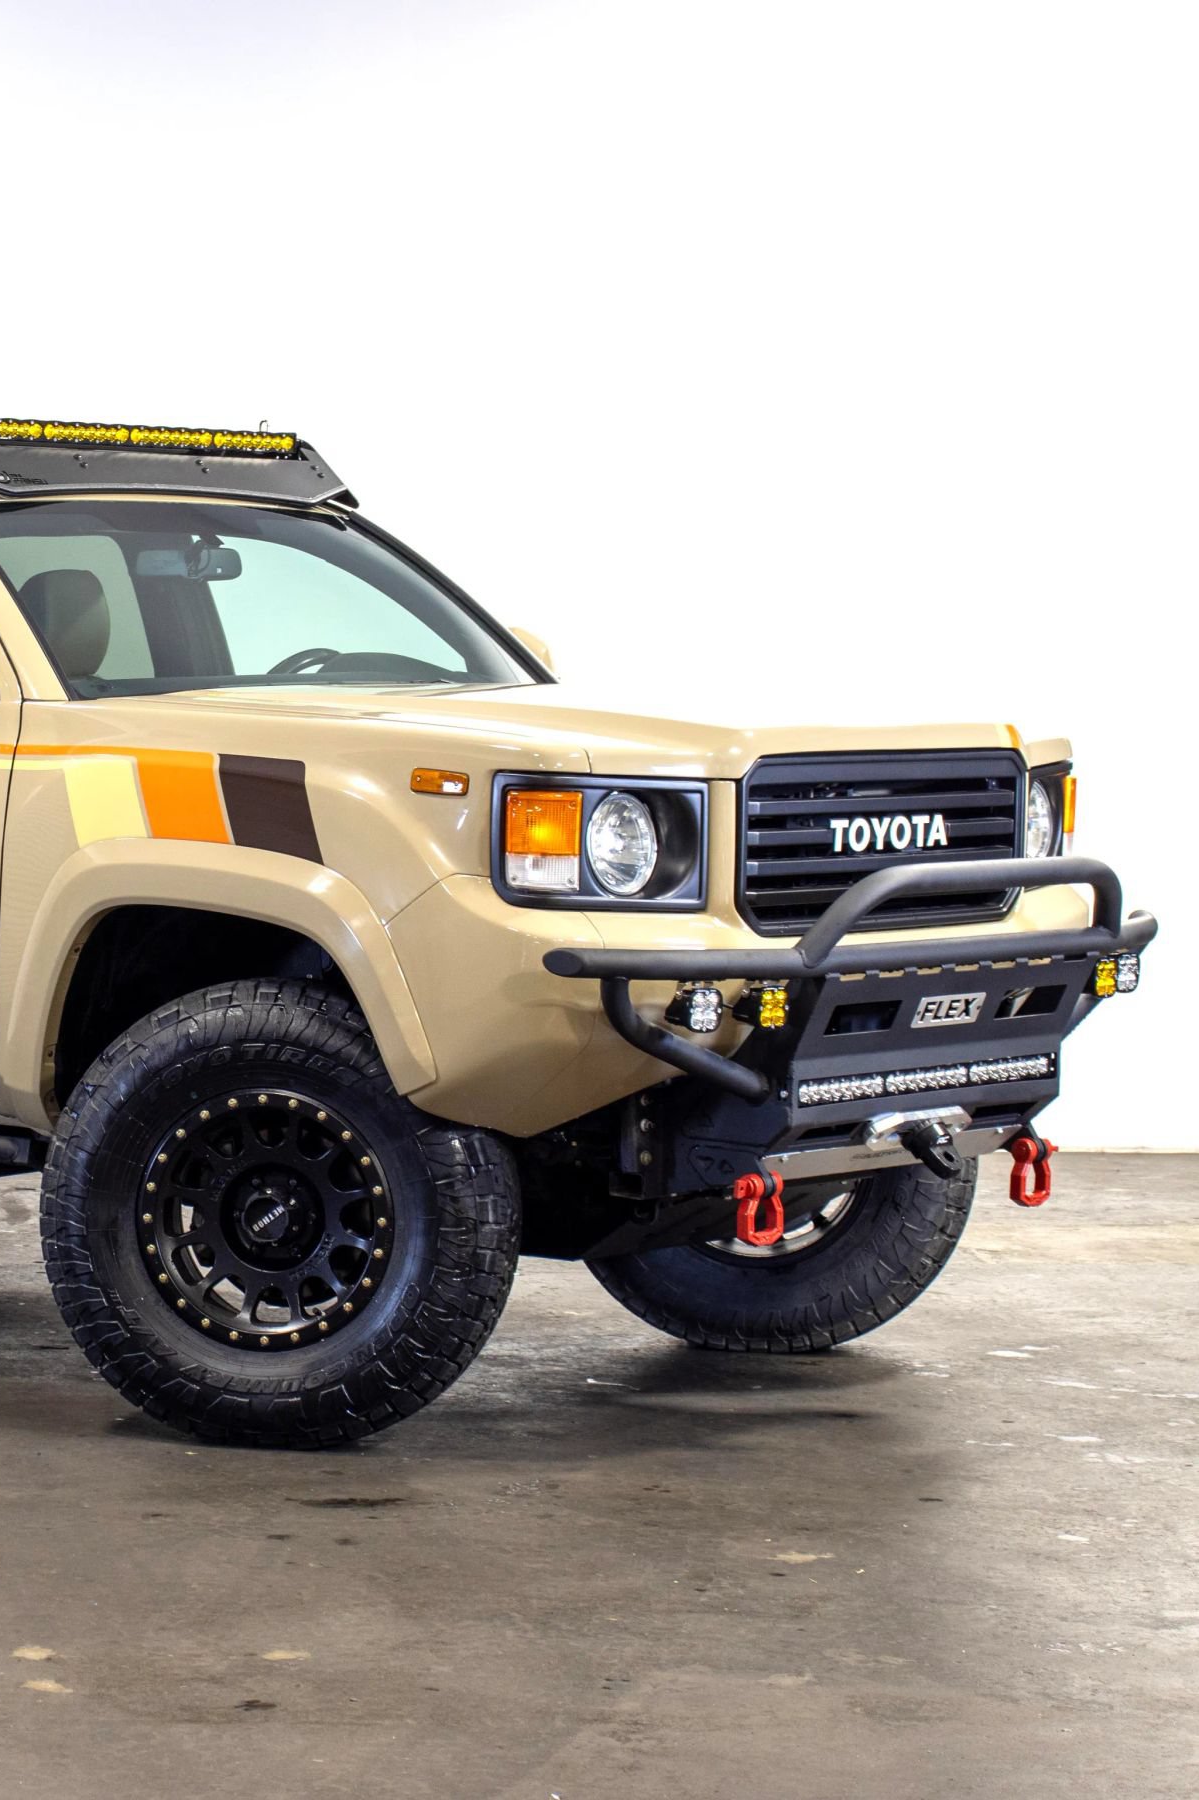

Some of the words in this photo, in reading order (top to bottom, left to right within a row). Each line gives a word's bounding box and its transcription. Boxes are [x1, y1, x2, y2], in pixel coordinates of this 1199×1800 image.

[829, 814, 948, 853] TOYOTA
[920, 997, 978, 1023] FLEX
[251, 1203, 286, 1233] METHOD
